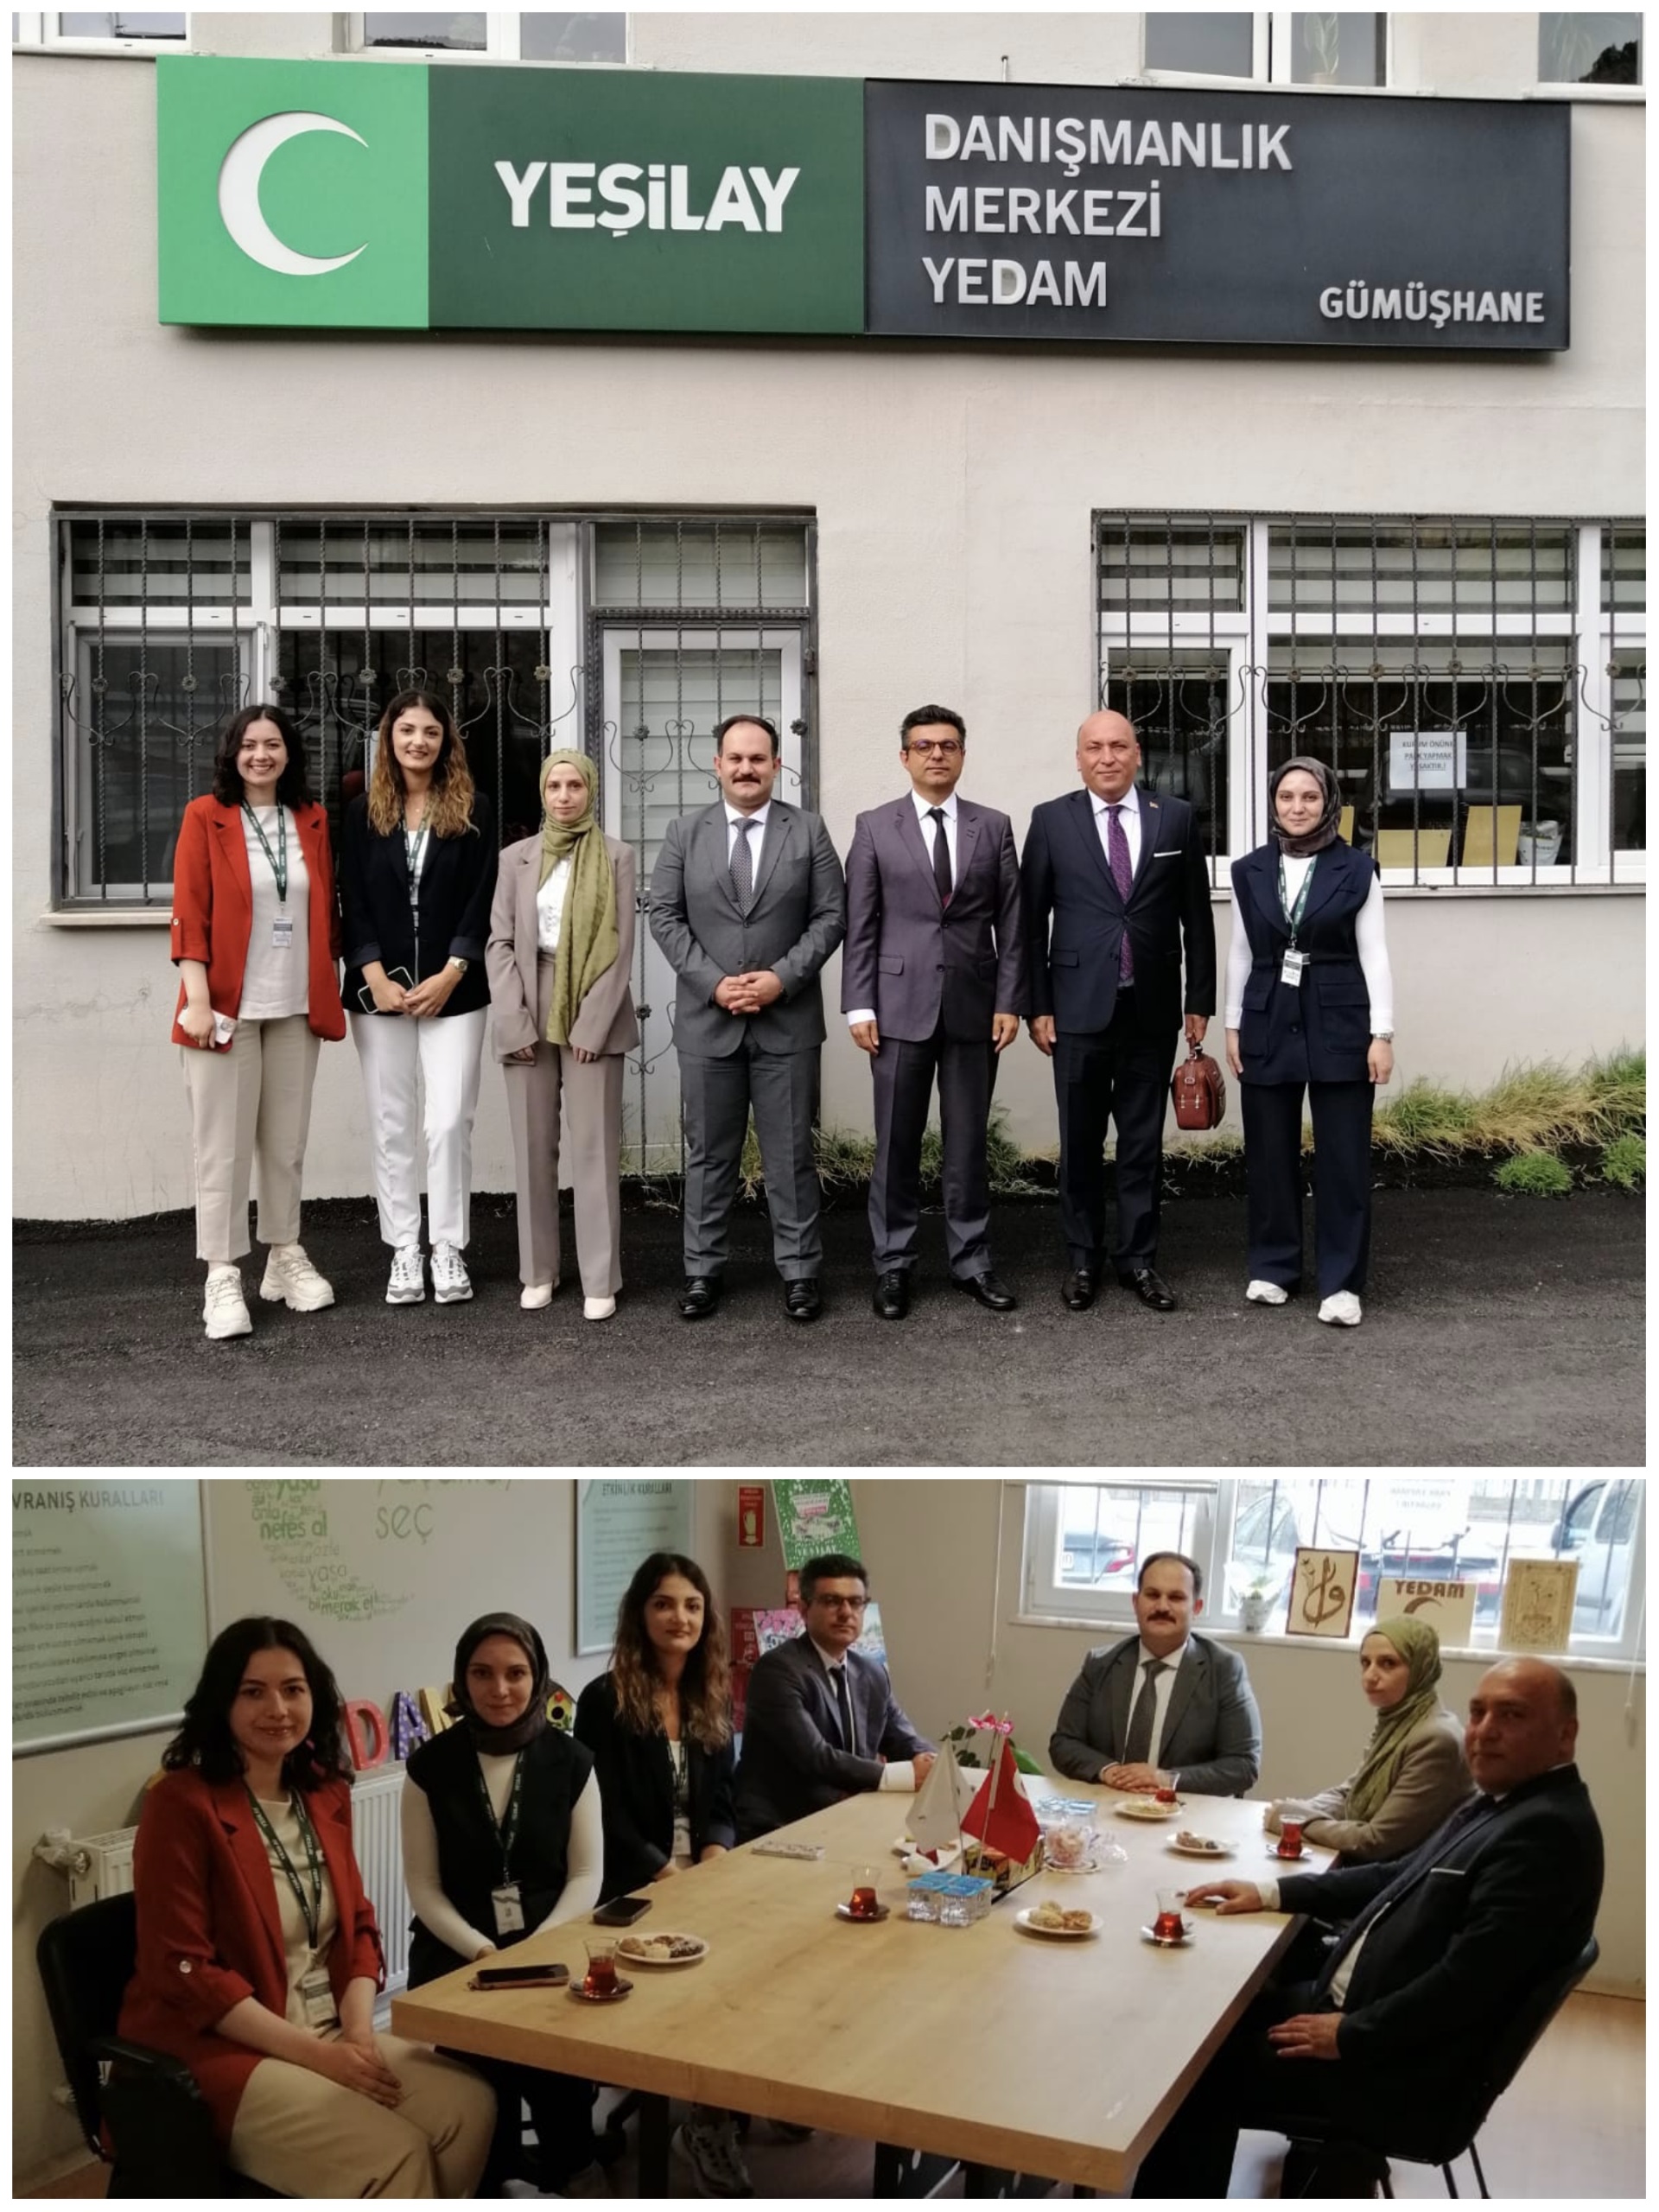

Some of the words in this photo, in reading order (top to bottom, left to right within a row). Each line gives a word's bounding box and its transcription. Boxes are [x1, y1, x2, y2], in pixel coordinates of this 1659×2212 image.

[925, 114, 1293, 177] DANIŞMANLIK
[925, 179, 1161, 238] MERKEZİ
[922, 257, 1108, 308] YEDAM
[1319, 279, 1545, 328] GÜMÜŞHANE
[260, 1510, 306, 1540] nefes
[311, 1510, 327, 1536] al
[375, 1503, 433, 1545] seç
[1395, 1580, 1465, 1598] YEDAM
